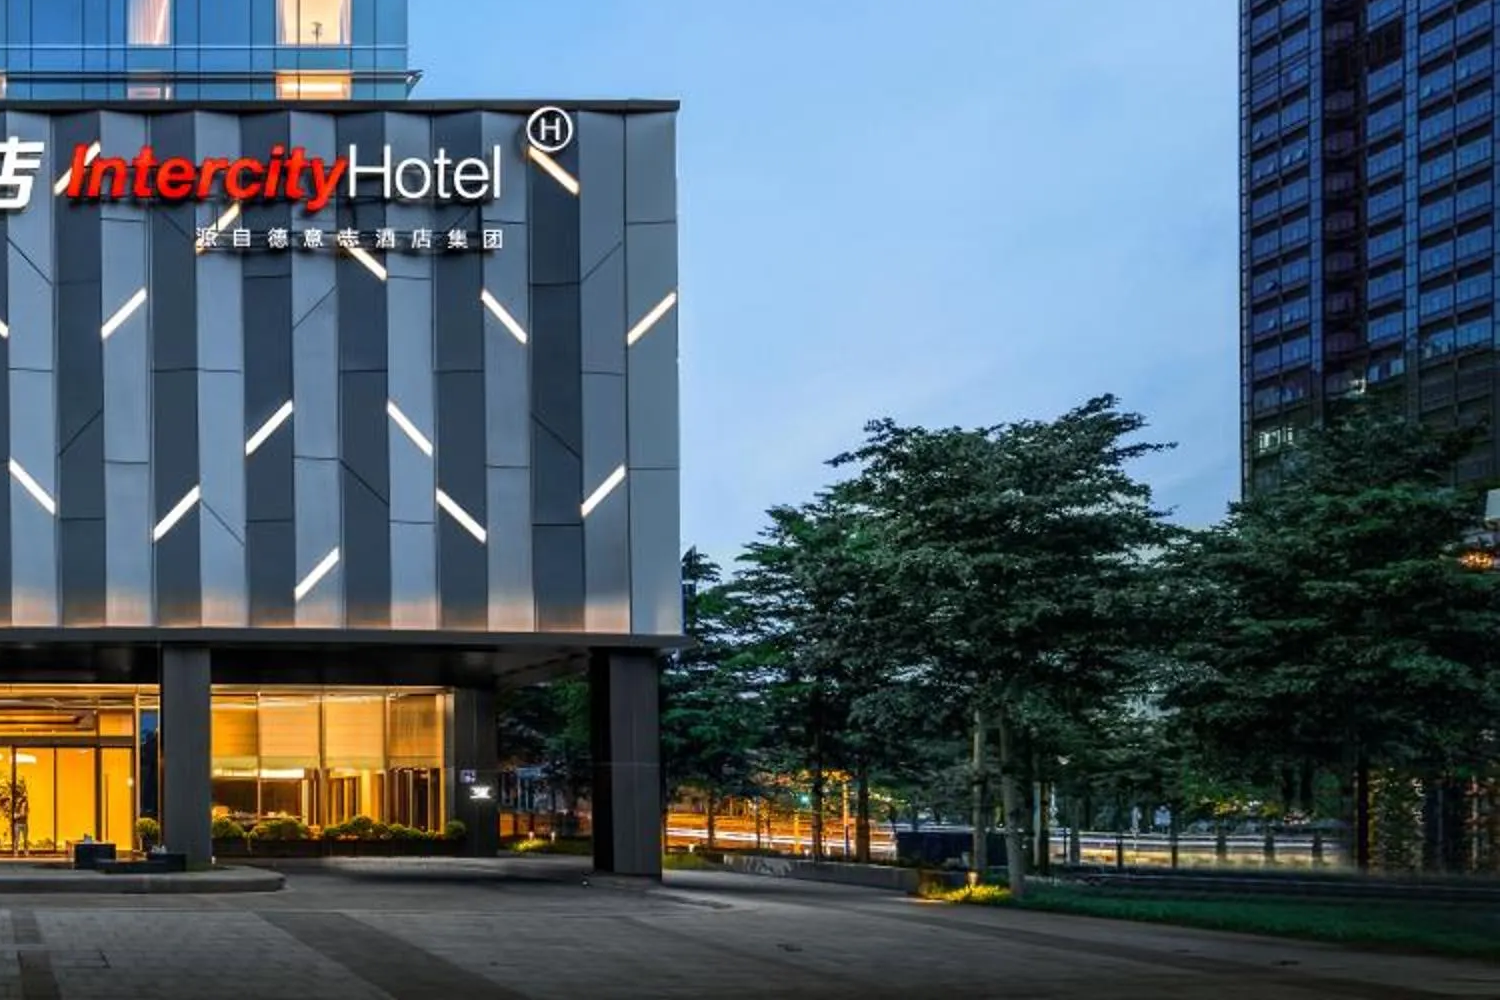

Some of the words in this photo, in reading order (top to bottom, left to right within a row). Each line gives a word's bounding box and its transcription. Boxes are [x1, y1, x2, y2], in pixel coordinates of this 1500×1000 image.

[196, 227, 504, 249] 源自德意志酒店集团
